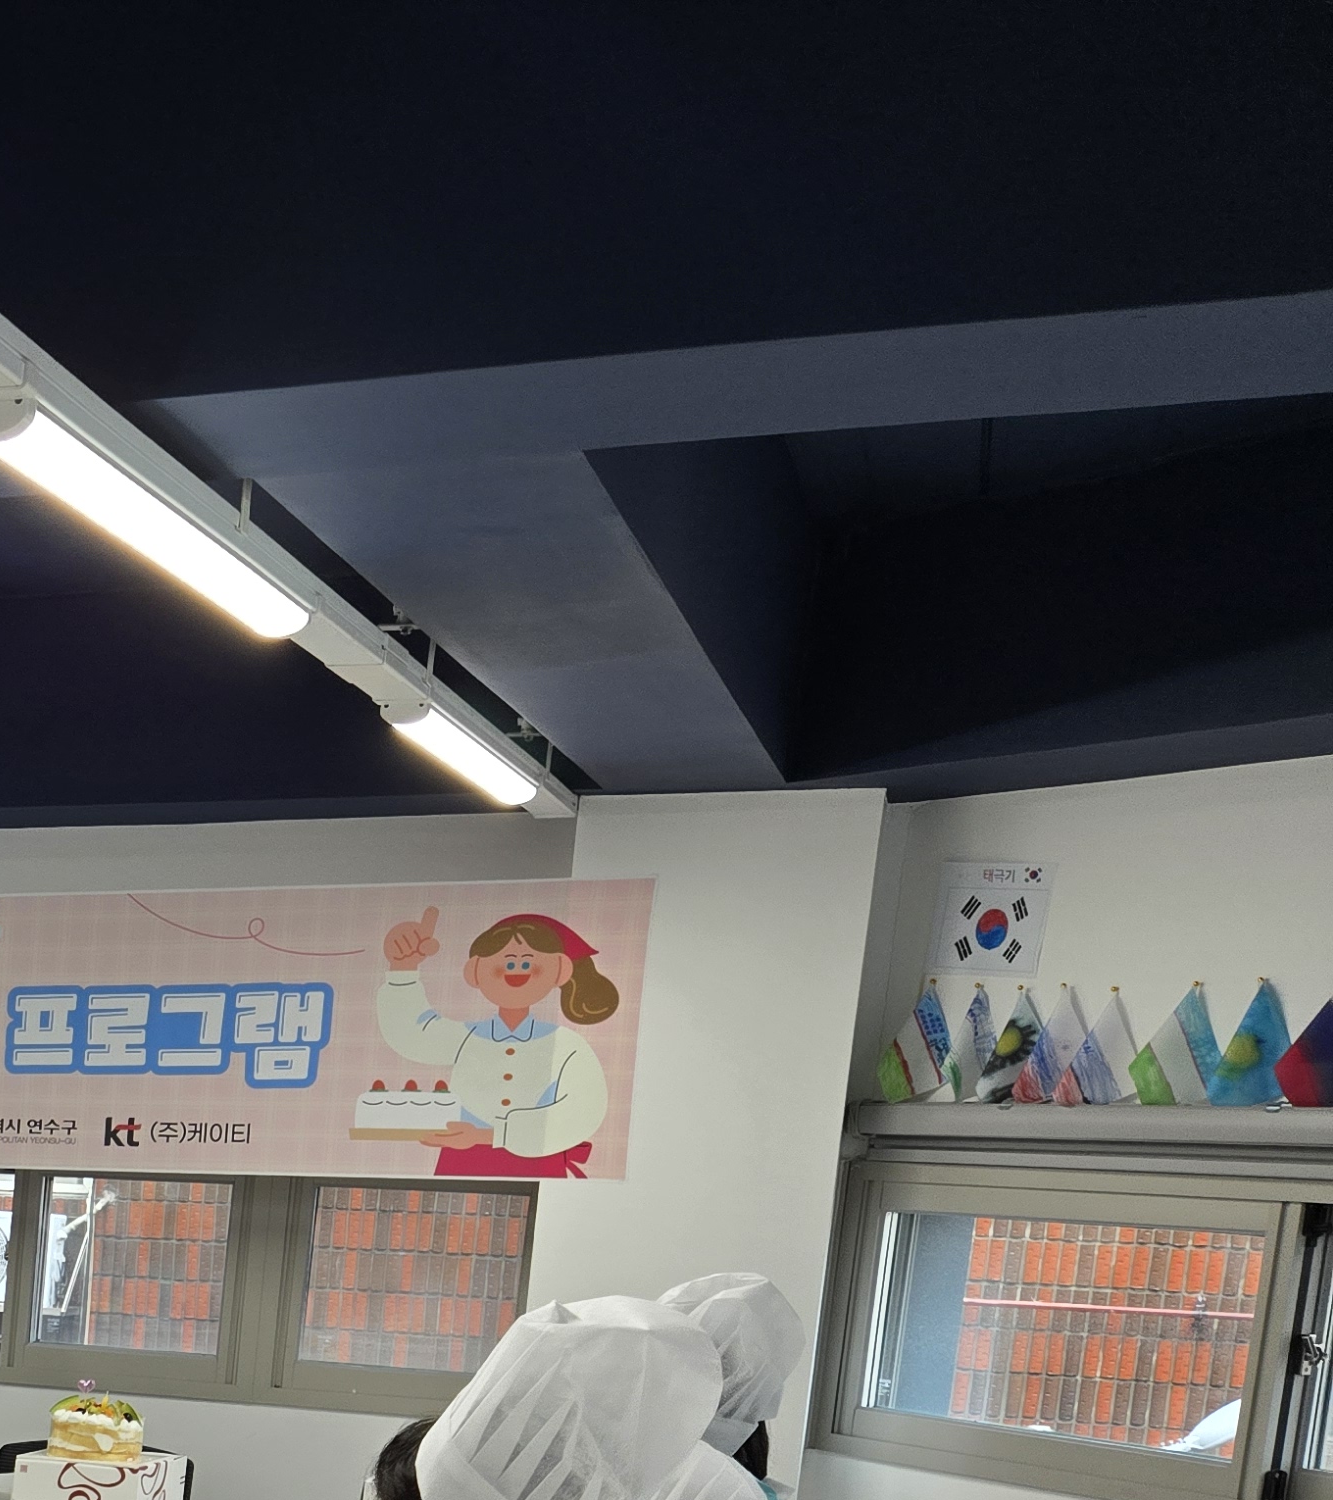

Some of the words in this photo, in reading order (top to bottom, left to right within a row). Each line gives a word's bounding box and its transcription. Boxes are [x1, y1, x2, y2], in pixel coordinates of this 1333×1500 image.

[983, 868, 1016, 884] 태극기
[7, 984, 331, 1086] 프로그램
[27, 1118, 77, 1136] 연수구
[103, 1117, 142, 1147] kt
[150, 1120, 252, 1144] (주)케이티
